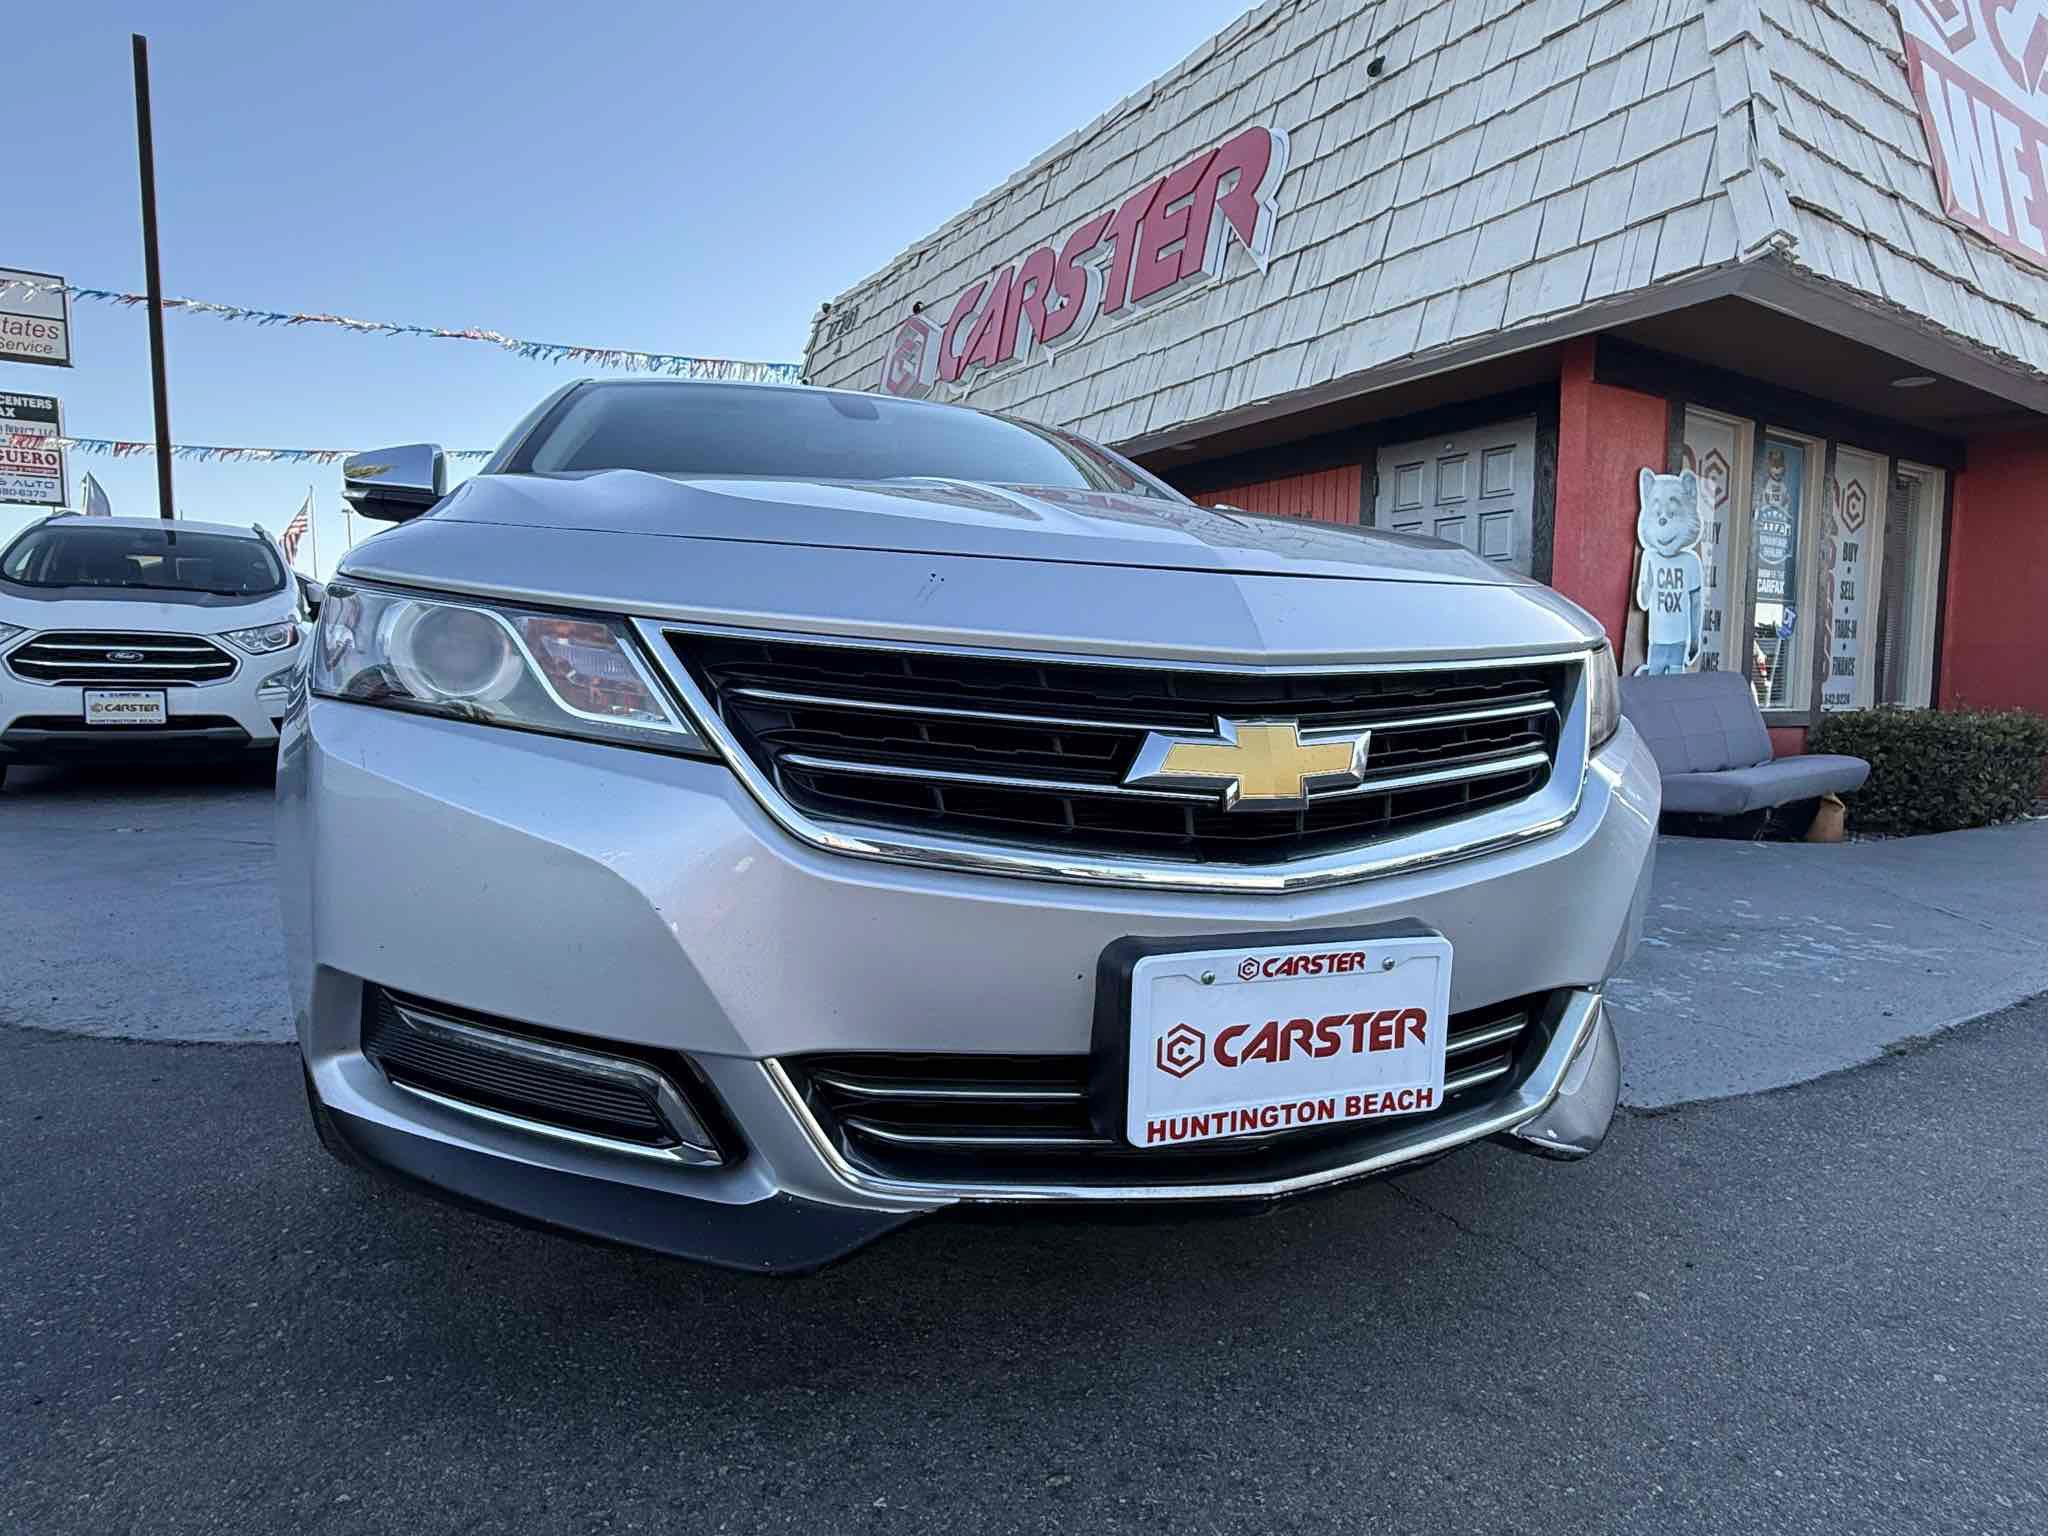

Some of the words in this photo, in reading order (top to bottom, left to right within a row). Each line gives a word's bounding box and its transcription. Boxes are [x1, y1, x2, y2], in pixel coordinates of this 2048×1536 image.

[938, 126, 1280, 385] CARSTER
[1842, 541, 1859, 563] BUY
[1656, 567, 1684, 590] CAR
[1756, 578, 1785, 594] CARFAX
[1839, 580, 1856, 601] SELL
[1657, 591, 1682, 613] FOX
[104, 703, 160, 713] CARSTER
[1262, 951, 1366, 978] CARSTER
[1213, 1007, 1429, 1068] CARSTER
[1146, 1098, 1336, 1144] HUNTINGTON
[1344, 1087, 1434, 1117] BEACH
